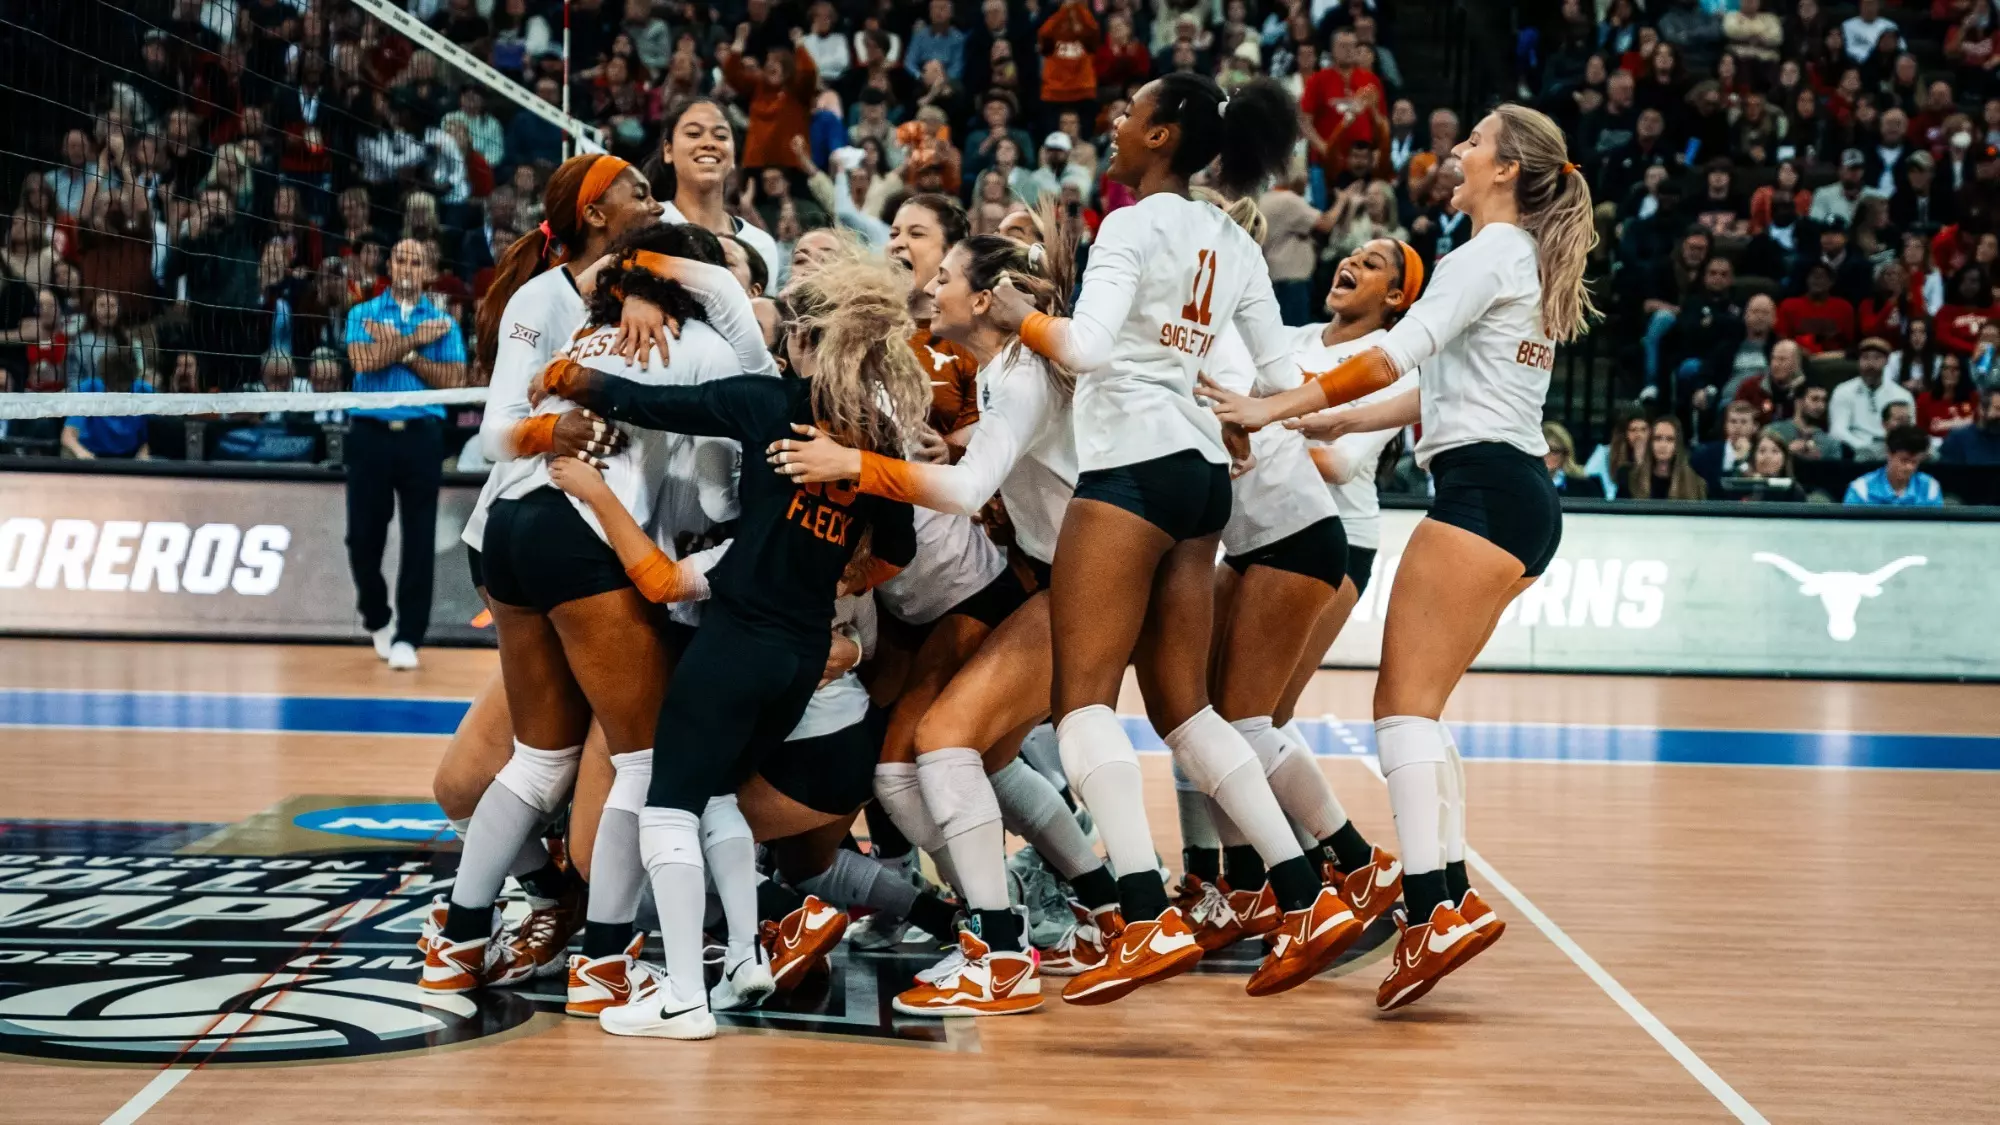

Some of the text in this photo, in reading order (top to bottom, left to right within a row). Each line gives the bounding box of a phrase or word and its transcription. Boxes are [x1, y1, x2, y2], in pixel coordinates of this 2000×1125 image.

[1181, 248, 1216, 326] 11
[785, 489, 854, 547] FLECK
[0, 518, 291, 596] OREROS
[0, 854, 367, 871] DIVISION
[0, 867, 458, 896] OLLEY
